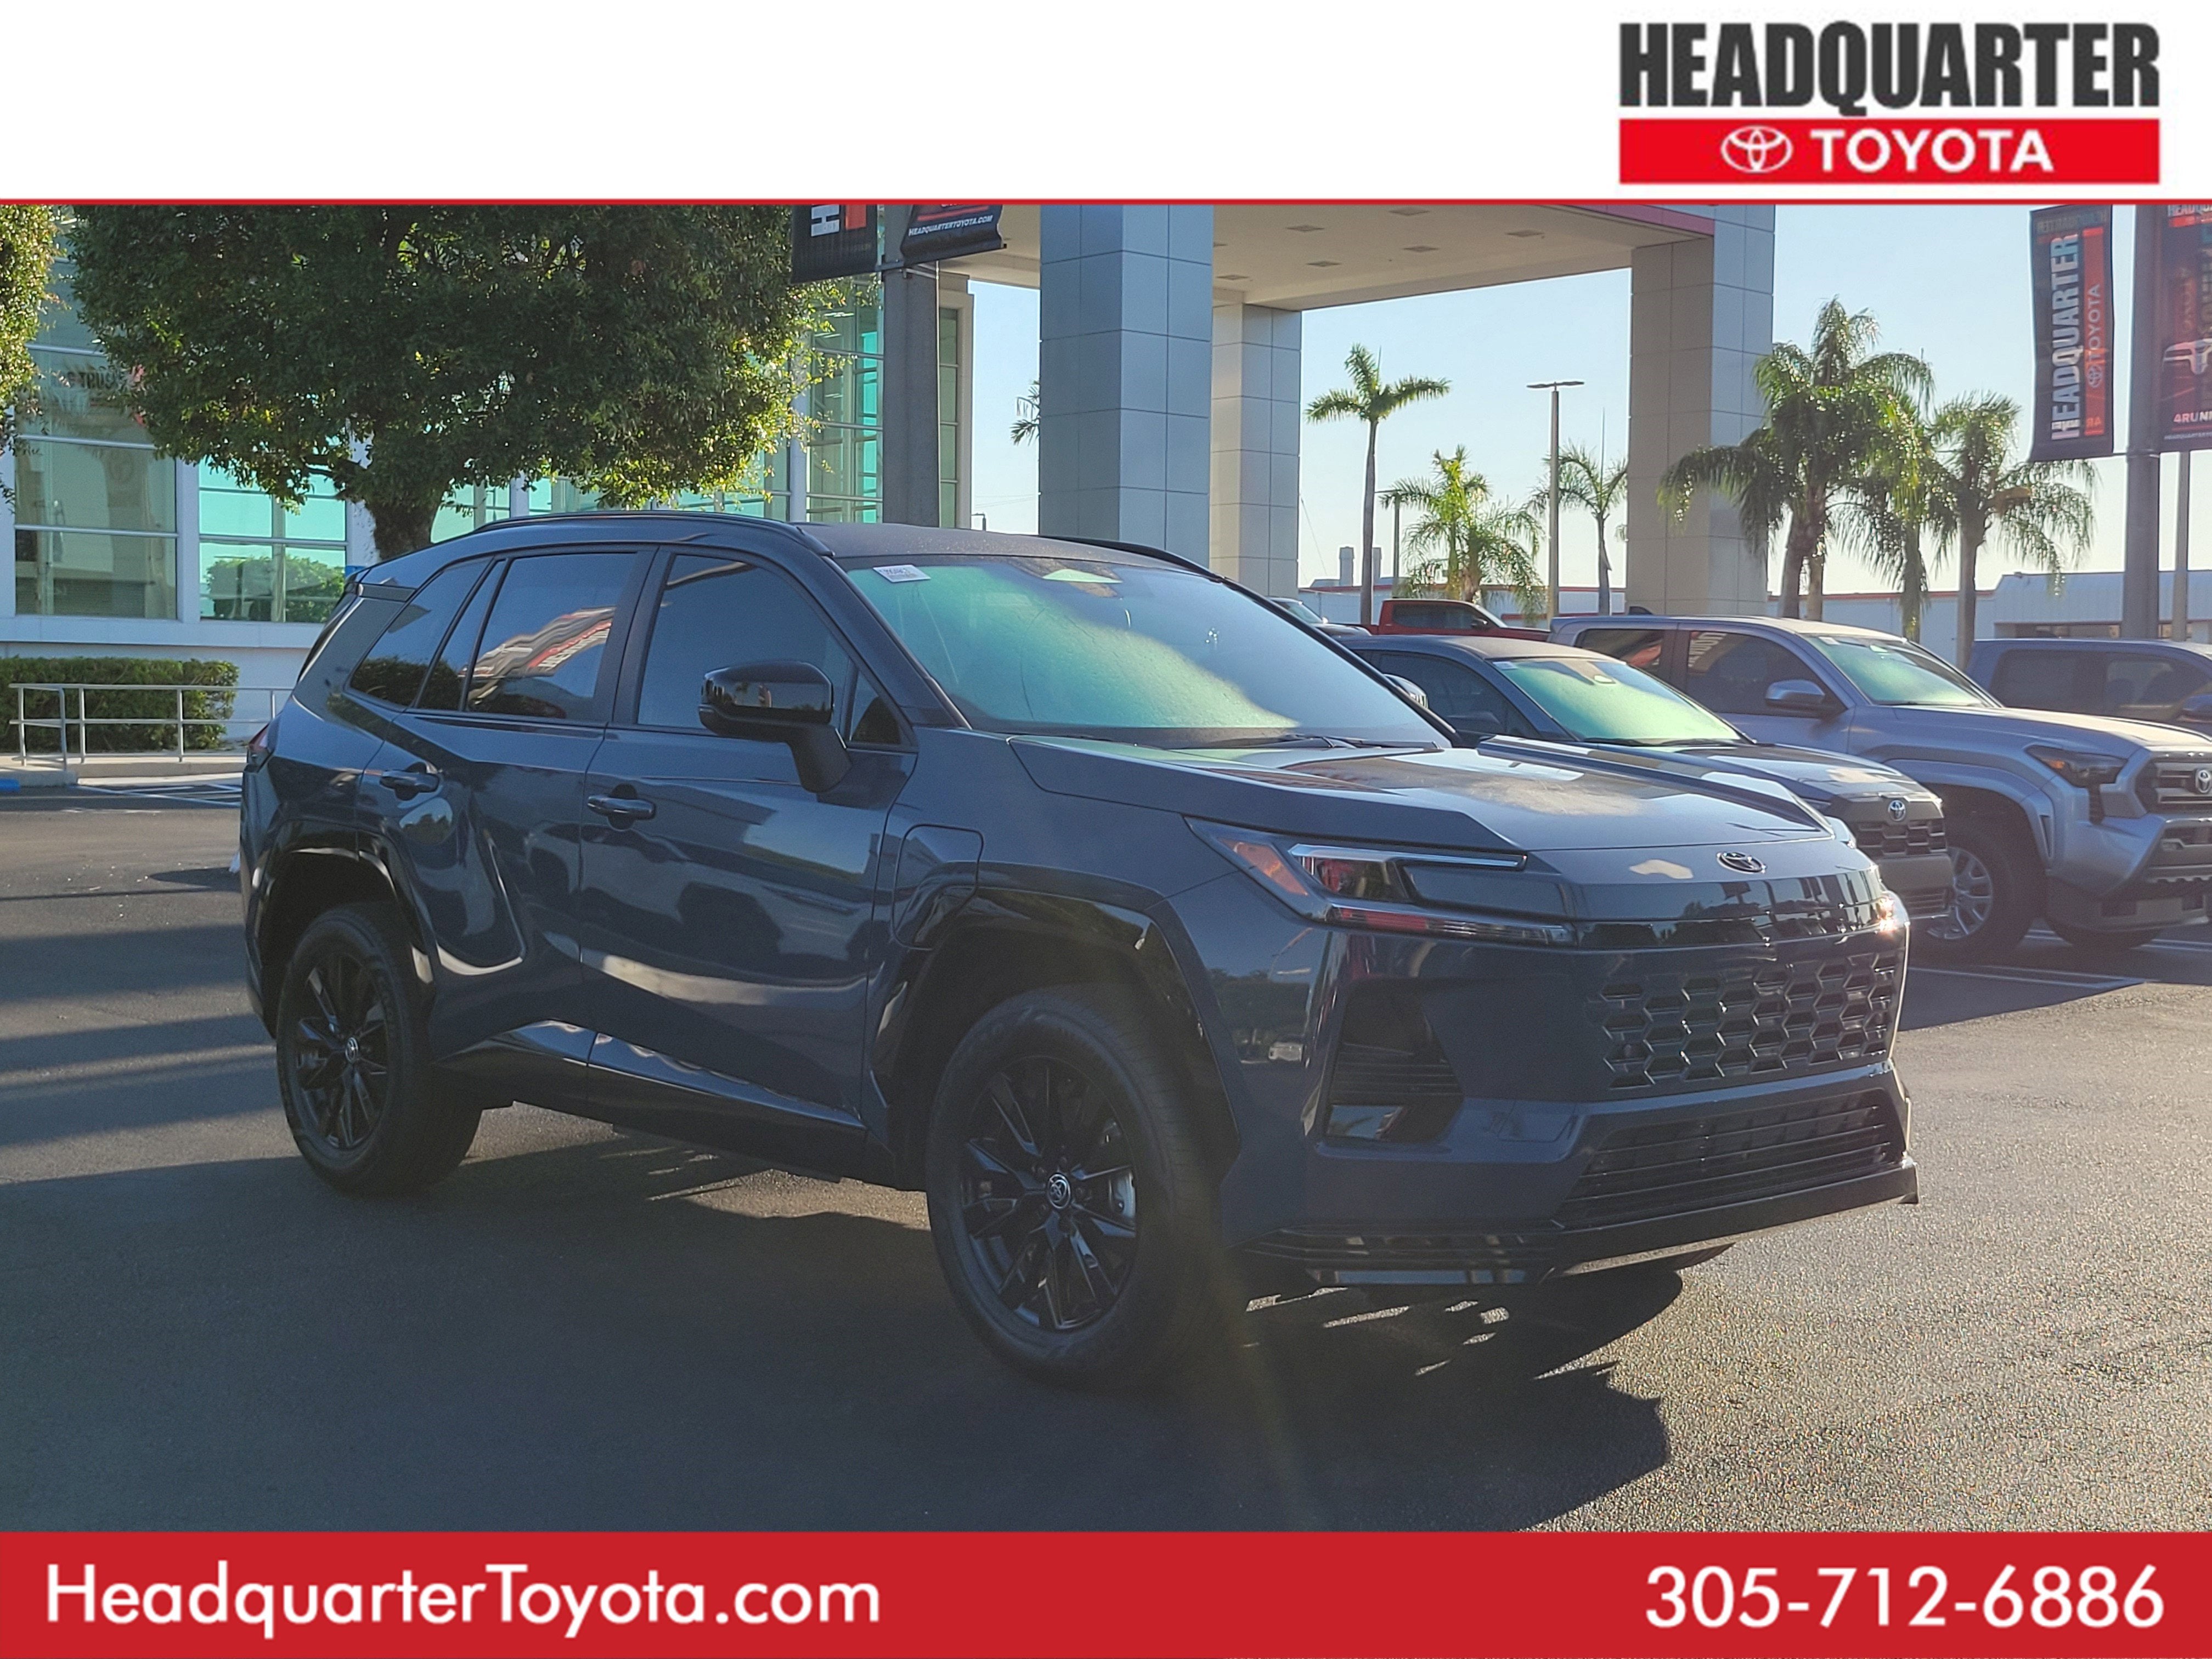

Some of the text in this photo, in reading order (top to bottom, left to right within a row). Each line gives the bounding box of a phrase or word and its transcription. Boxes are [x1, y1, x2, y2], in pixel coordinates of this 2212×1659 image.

[908, 215, 994, 237] HEADQUARTERTOYOTA.COM
[2051, 234, 2084, 439] HEADQUARTER
[2087, 284, 2101, 362] TOYOTA
